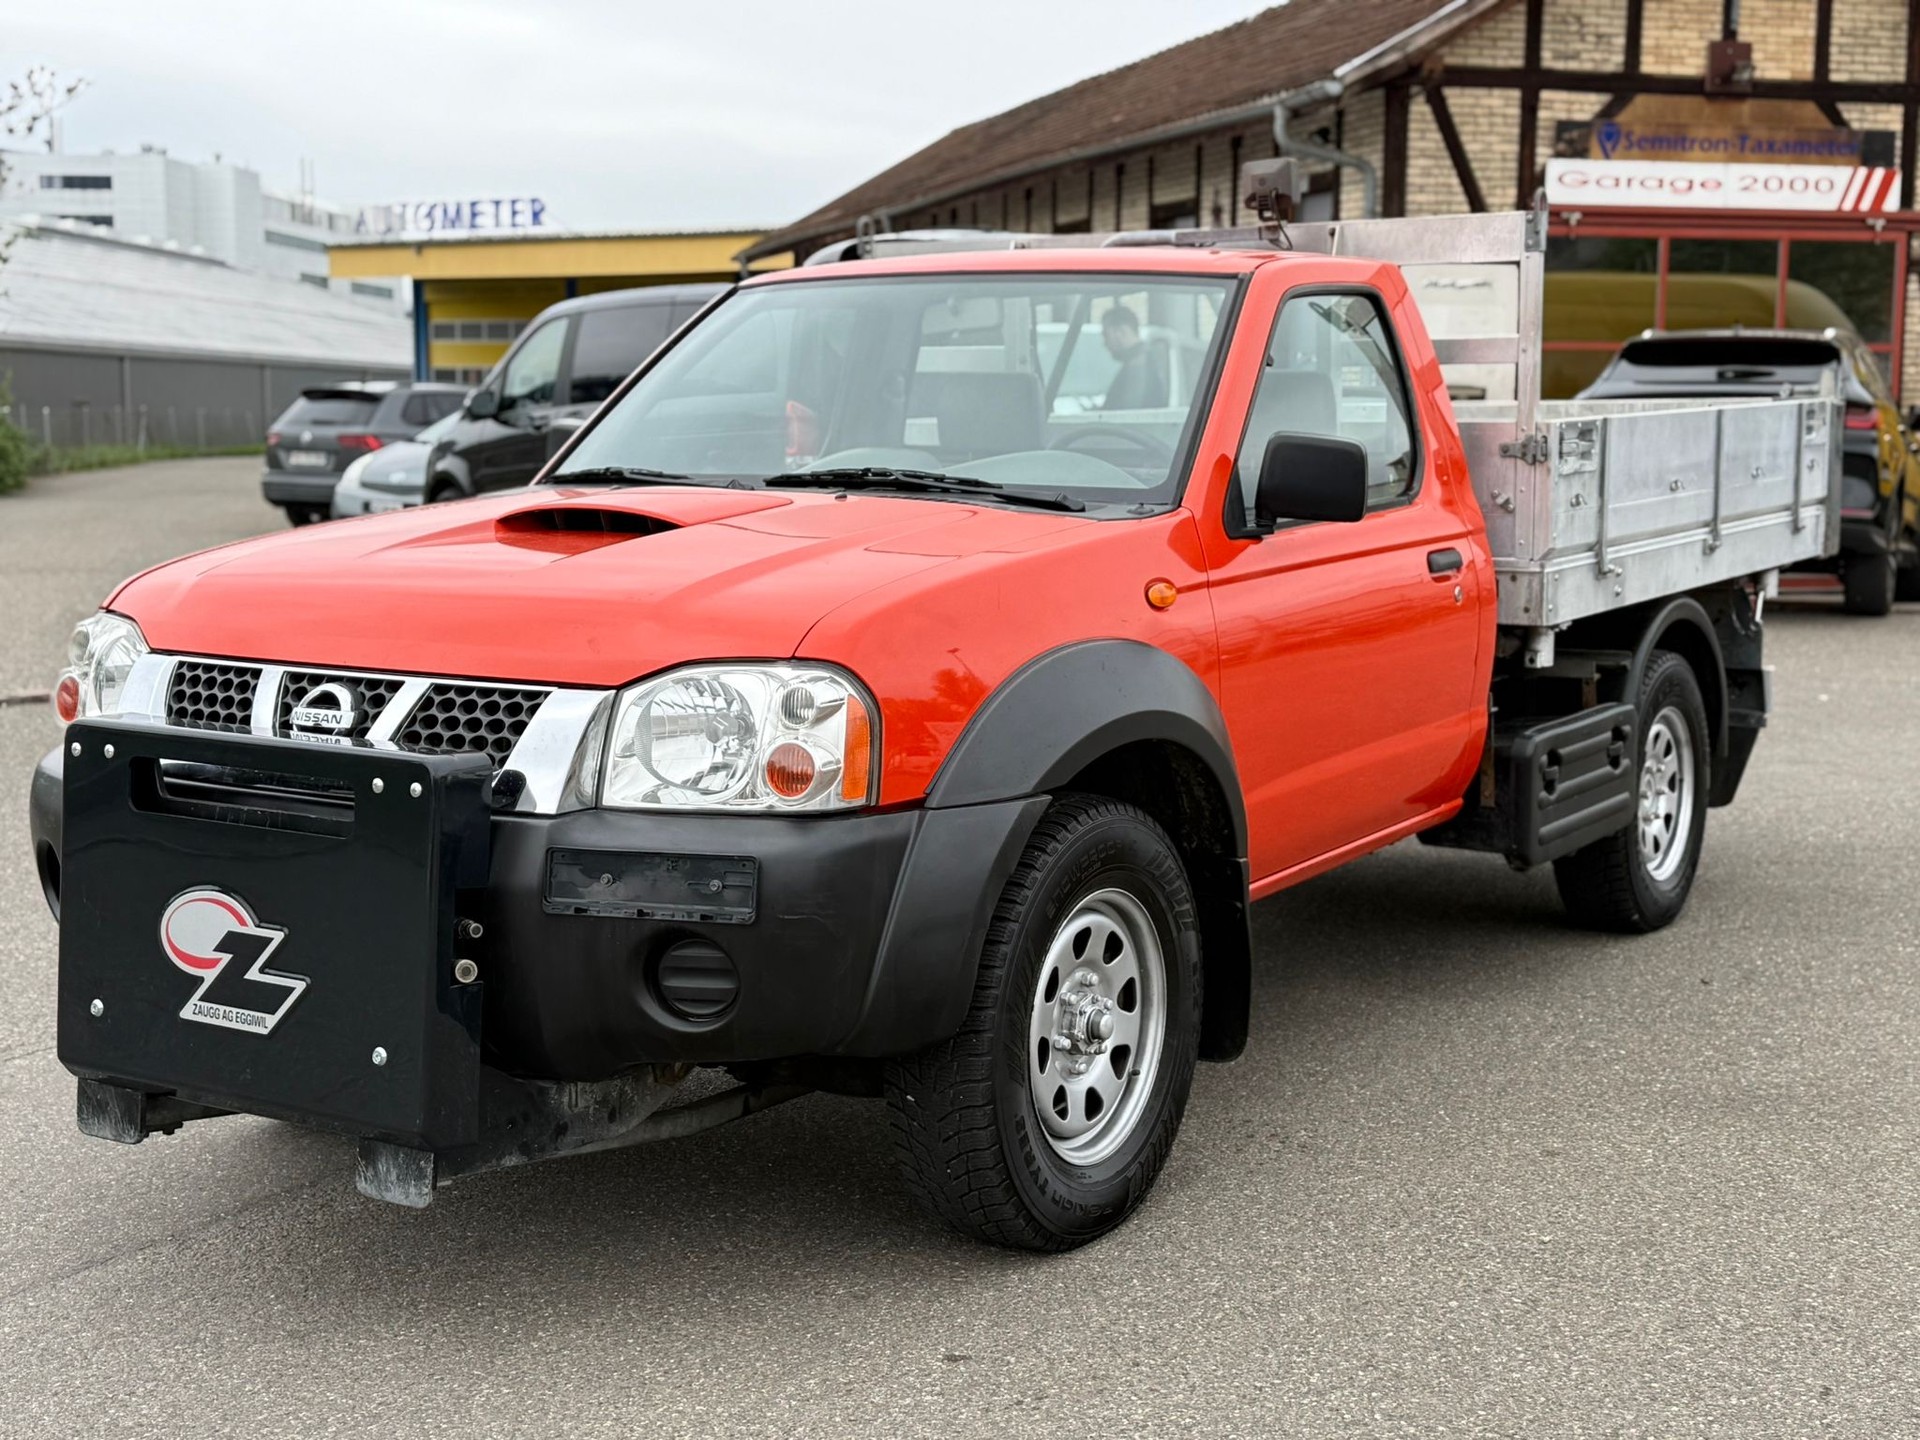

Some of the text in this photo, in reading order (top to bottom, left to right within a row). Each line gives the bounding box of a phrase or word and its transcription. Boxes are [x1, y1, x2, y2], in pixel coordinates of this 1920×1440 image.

[1557, 170, 1835, 195] Garage 2000
[293, 710, 343, 725] NISSAN
[192, 1003, 268, 1029] ZAUGG AG EGGIWIL
